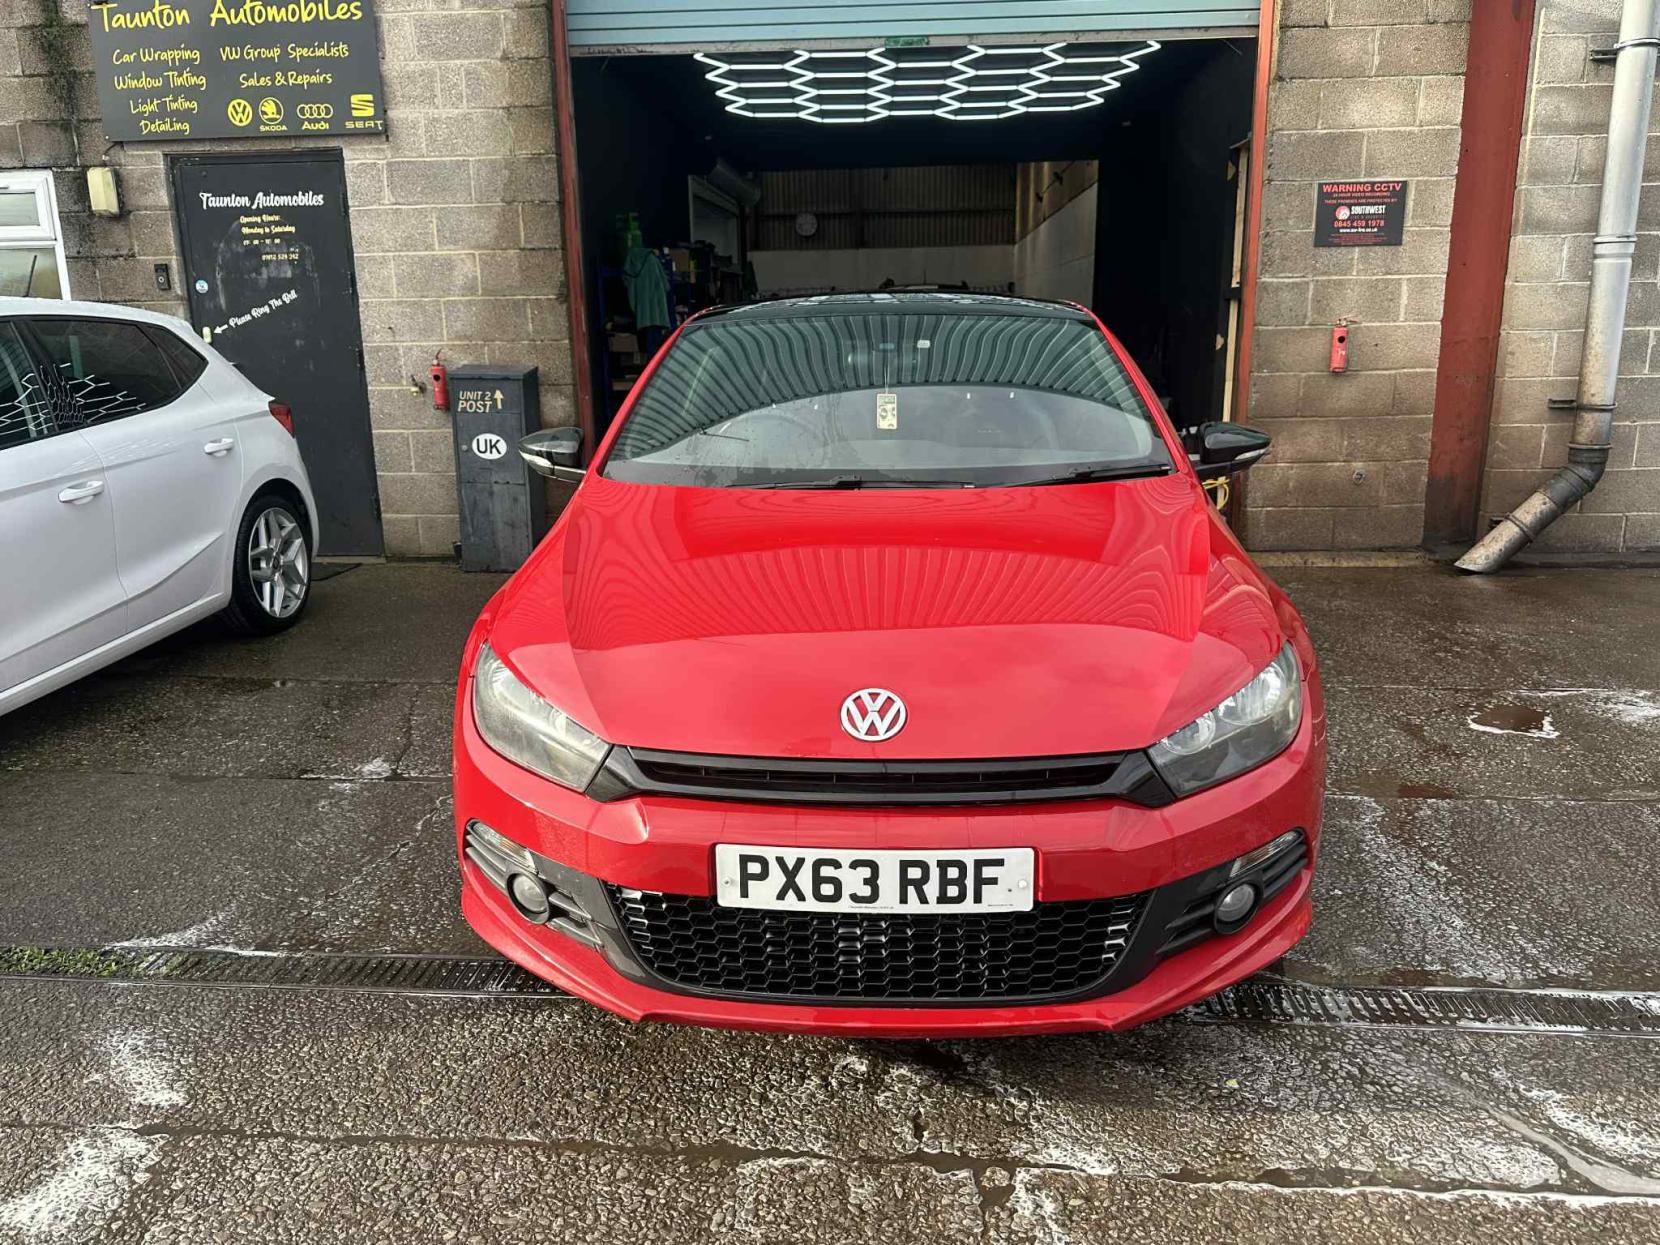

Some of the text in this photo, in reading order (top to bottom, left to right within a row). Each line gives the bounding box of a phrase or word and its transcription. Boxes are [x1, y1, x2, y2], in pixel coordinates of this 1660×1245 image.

[91, 0, 363, 32] Taunton Automobiles
[113, 44, 201, 65] Car Wrapping
[220, 41, 350, 65] VW Group Specialists
[114, 67, 206, 91] Window Tinting
[239, 72, 272, 88] Sales
[288, 68, 333, 90] Repairs
[129, 93, 198, 117] Light Tinting
[140, 117, 190, 136] Detailing
[302, 120, 330, 131] Audi
[345, 120, 384, 131] SEAT
[1322, 183, 1402, 193] WARNING CCTV
[199, 190, 325, 210] Taunton Automobiles
[1351, 205, 1386, 214] SOUTHWEST
[271, 225, 296, 233] Saturday
[1367, 219, 1385, 227] 1978
[228, 289, 298, 328] Please Ring The Bell
[459, 390, 492, 401] UNIT 2
[457, 400, 493, 413] POST
[476, 438, 502, 455] UK
[738, 853, 1005, 905] PX63 RBF
